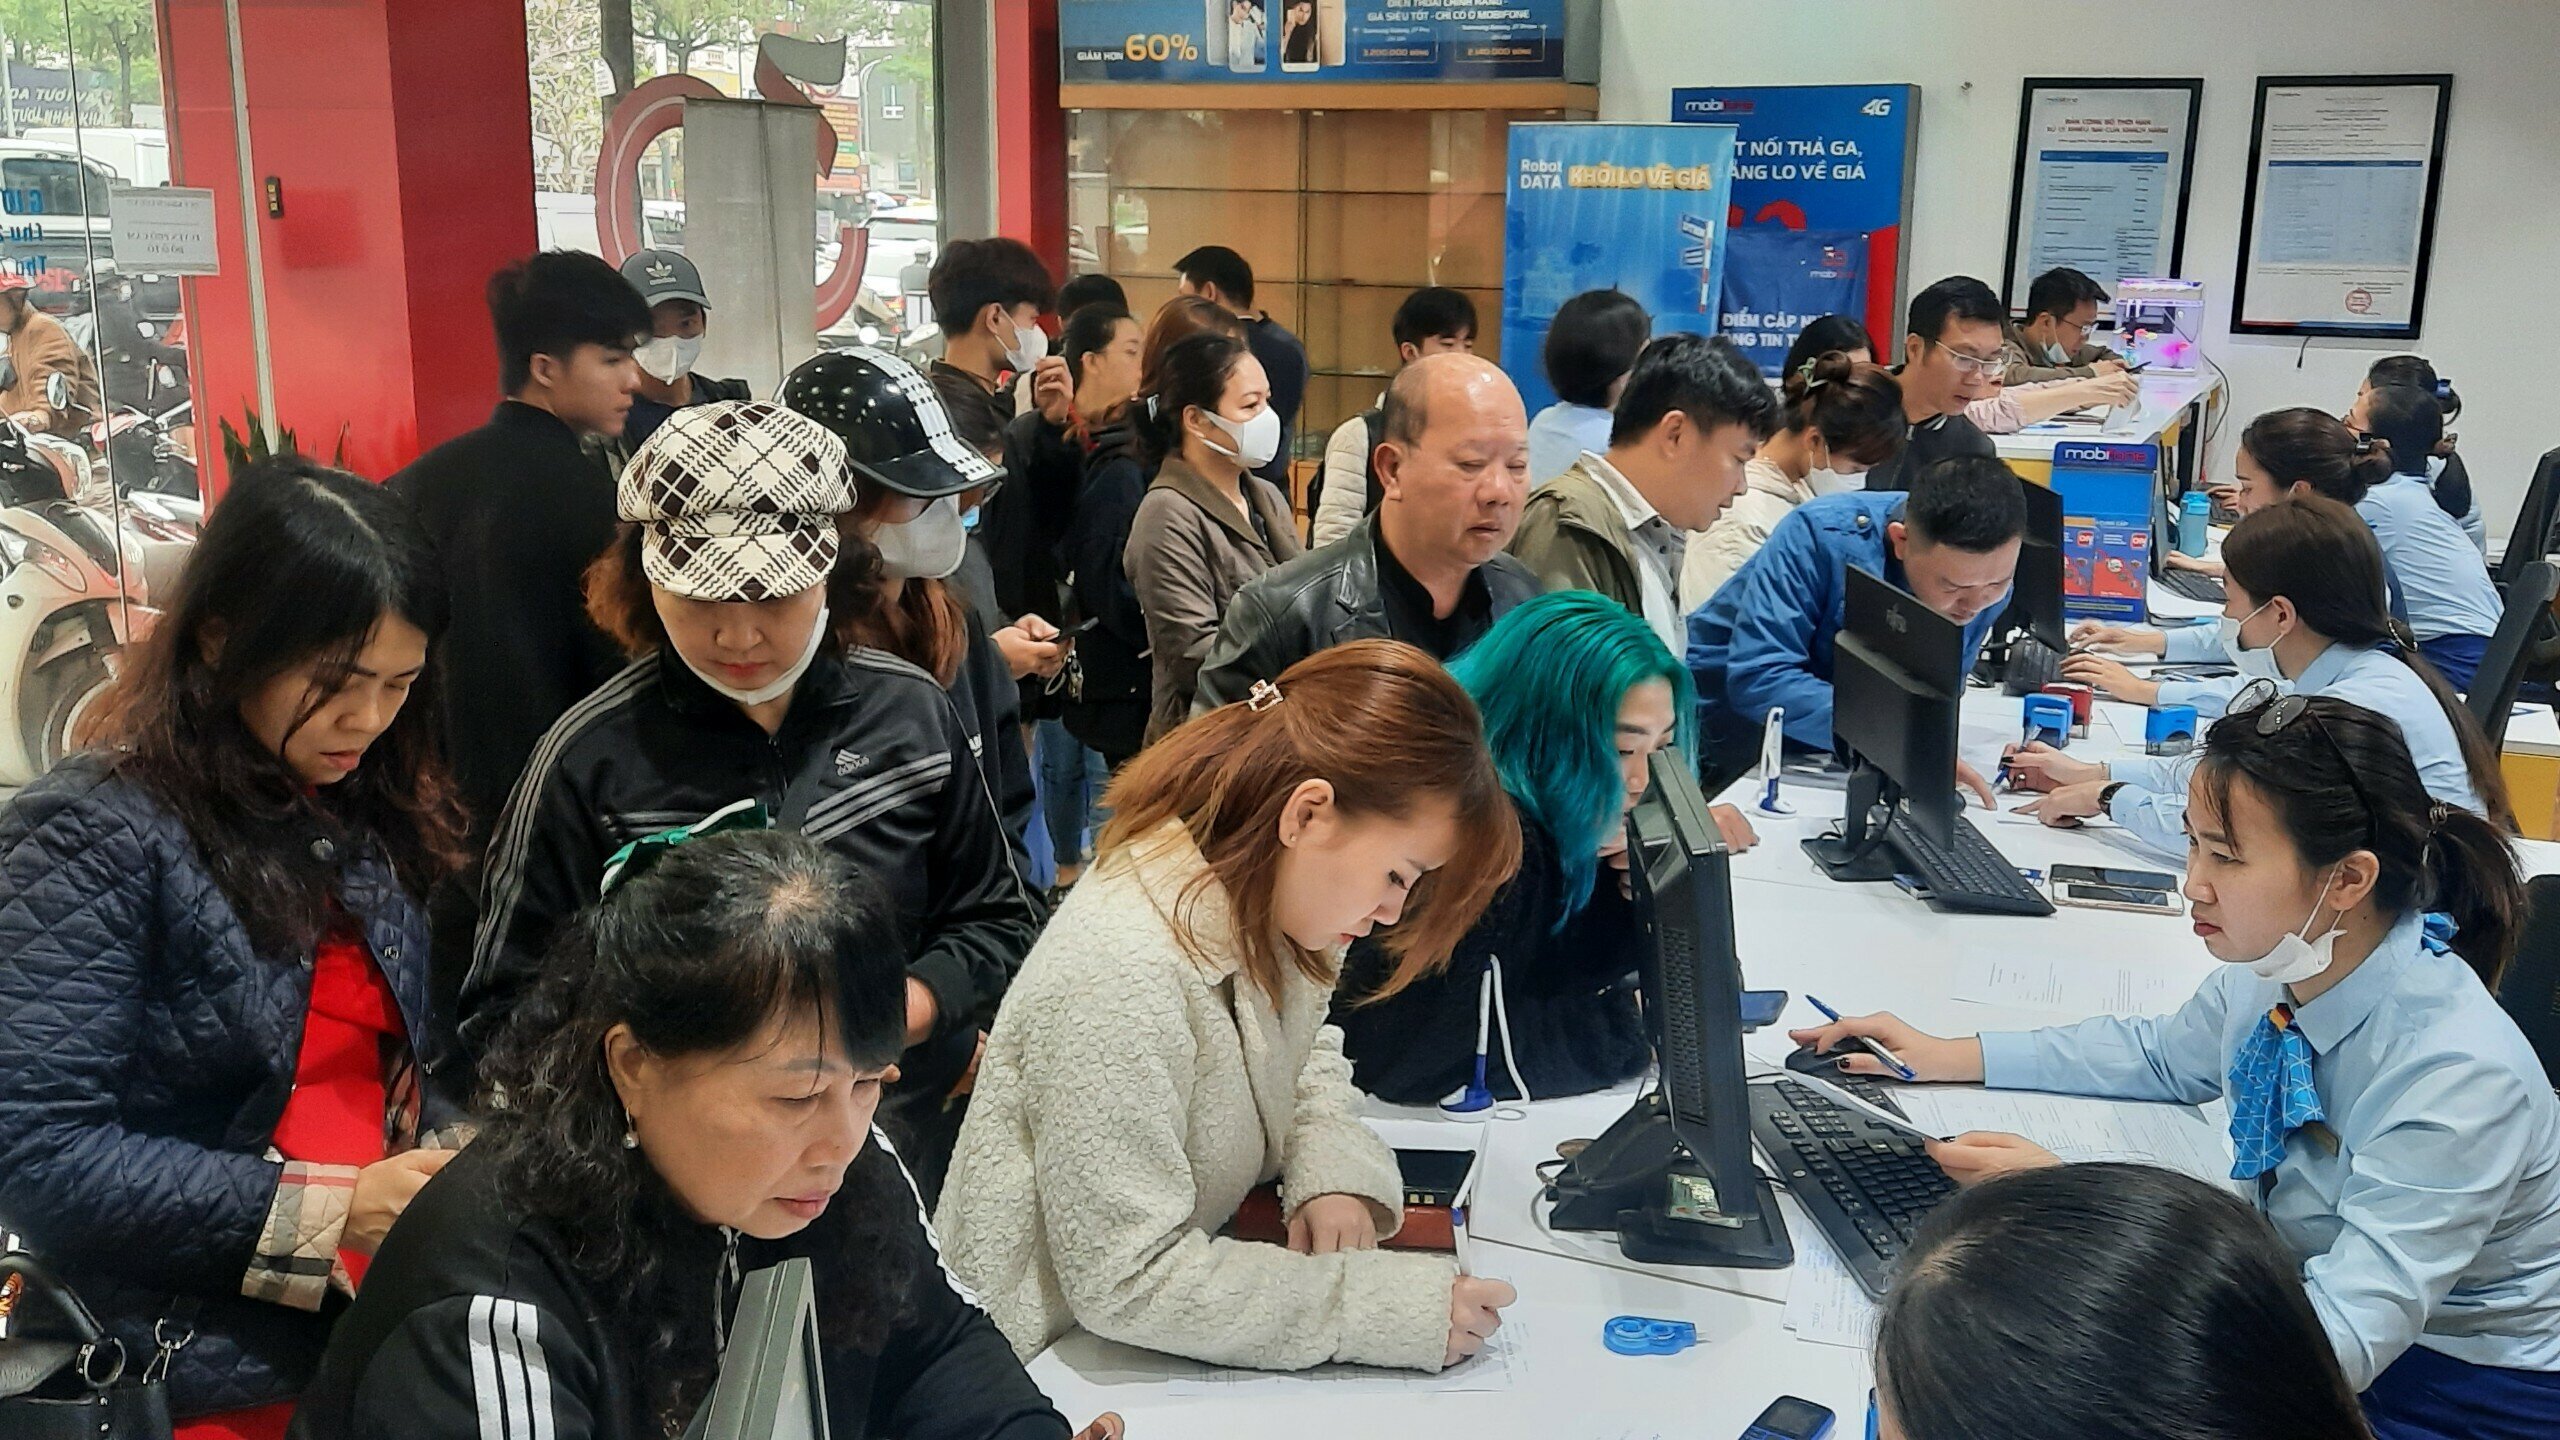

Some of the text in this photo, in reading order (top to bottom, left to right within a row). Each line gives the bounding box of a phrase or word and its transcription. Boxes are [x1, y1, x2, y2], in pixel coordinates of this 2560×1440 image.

[1125, 33, 1198, 62] 60%
[10, 87, 30, 100] OA
[1860, 98, 1892, 116] 4G
[1751, 136, 1782, 157] NỐI
[1787, 136, 1825, 156] THẢ
[1830, 141, 1863, 158] GA,
[1520, 158, 1563, 173] Robot
[1772, 164, 1797, 180] LO
[1801, 160, 1828, 180] VỀ
[1832, 160, 1867, 180] GIÁ
[1520, 174, 1563, 189] DATA
[1619, 168, 1644, 187] LO
[1676, 164, 1711, 188] GIÁ
[1722, 306, 1760, 327] ĐIỂM
[1763, 311, 1797, 332] CẬP
[1760, 333, 1784, 347] TIN
[2065, 446, 2147, 463] mobifone
